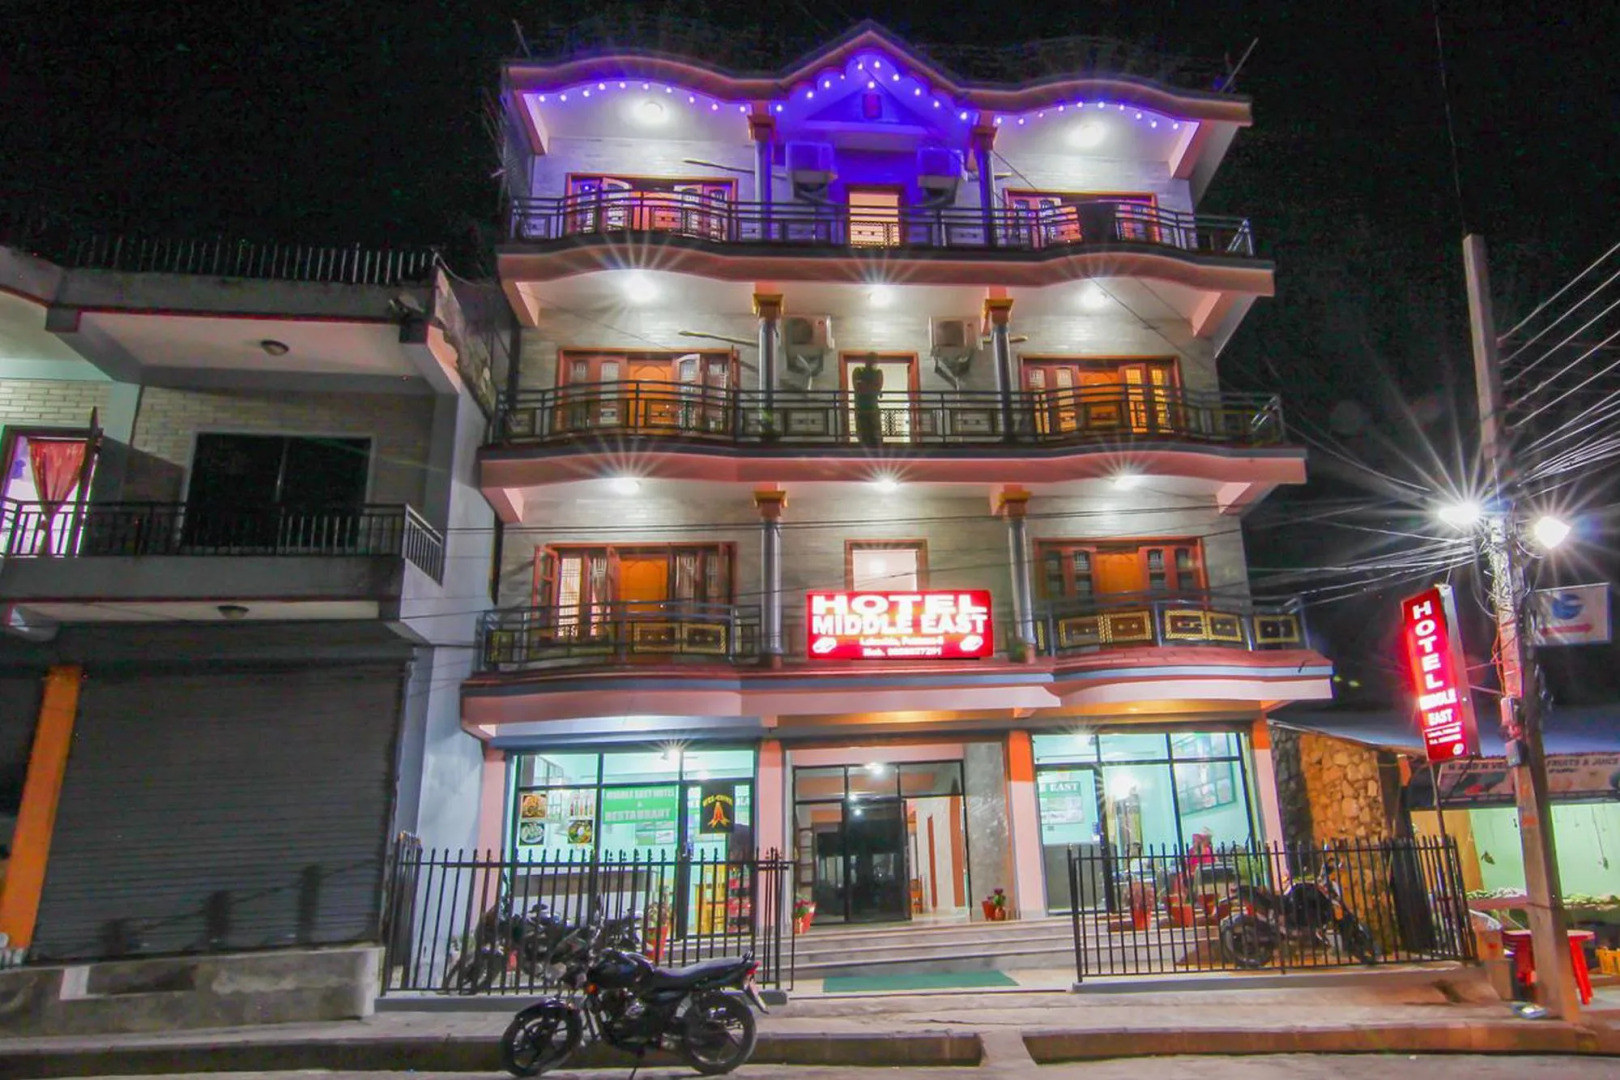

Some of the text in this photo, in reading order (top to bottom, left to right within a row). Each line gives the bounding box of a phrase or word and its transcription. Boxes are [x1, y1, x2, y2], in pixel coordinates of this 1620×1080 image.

[812, 594, 988, 615] HOTEL
[812, 614, 988, 636] MIDDLE EAST
[1411, 600, 1444, 690] HOTEL
[1427, 708, 1452, 726] EAST
[1049, 783, 1078, 792] EAST
